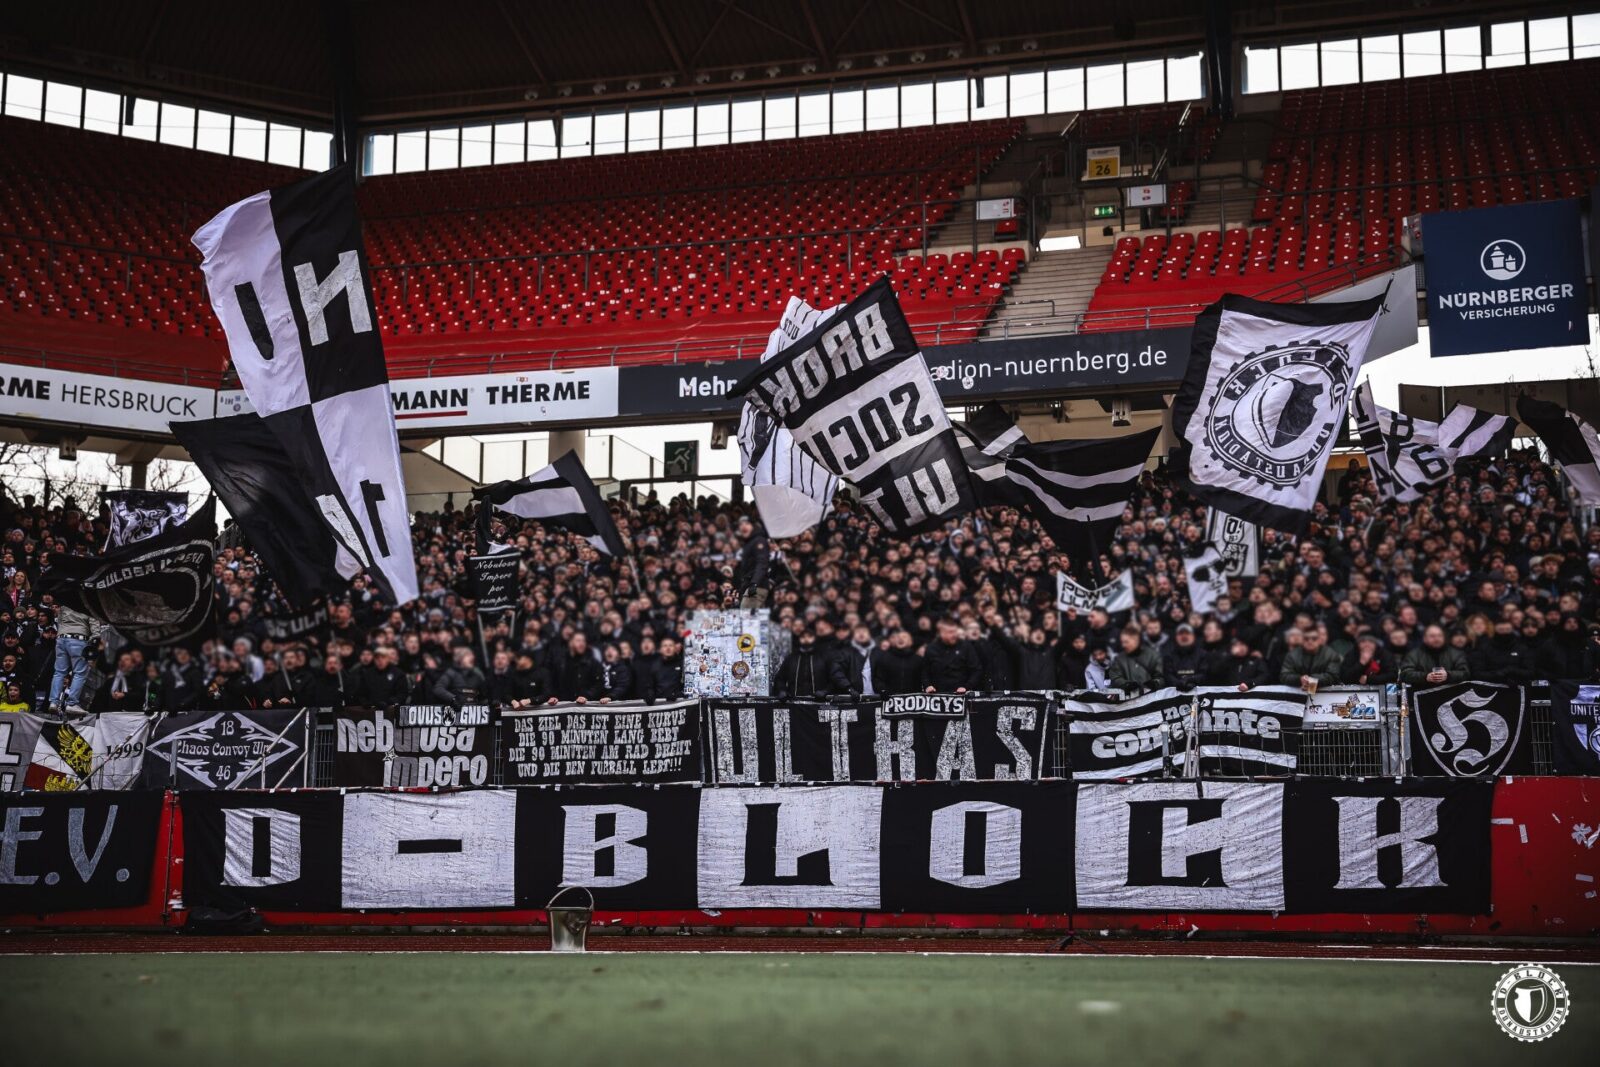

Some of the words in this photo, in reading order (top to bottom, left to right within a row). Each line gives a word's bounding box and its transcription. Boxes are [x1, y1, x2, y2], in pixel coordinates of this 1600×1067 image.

[1095, 164, 1111, 176] 26
[1438, 283, 1574, 309] NÜRNBERGER
[1460, 303, 1556, 321] VERSICHERUNG
[61, 383, 197, 417] HERSBRUCK
[486, 380, 590, 405] THERME
[884, 696, 964, 714] PRODIGYS
[221, 720, 234, 736] 18
[514, 717, 533, 733] DAS
[538, 715, 561, 731] ZIEL
[567, 714, 586, 730] DAS
[591, 714, 609, 730] IST
[614, 714, 642, 730] EINE
[647, 709, 687, 729] KURVE
[337, 710, 475, 752] nebulosa
[518, 732, 536, 747] DIE
[542, 731, 555, 746] 90
[561, 730, 609, 745] MINUTEN
[614, 729, 644, 744] LANG
[106, 742, 143, 760] 1999
[212, 742, 250, 758] Convoy
[713, 705, 1037, 782] ULTRAS
[508, 747, 525, 762] DIE
[531, 747, 546, 762] 90
[551, 745, 596, 761] MINUTEN
[601, 744, 619, 760] AM
[625, 744, 649, 760] RAD
[216, 765, 231, 780] 46
[382, 754, 488, 787] impero
[517, 763, 538, 778] UND
[543, 762, 560, 777] DIE
[565, 761, 586, 776] DEN
[0, 804, 130, 885] E.V.
[220, 797, 1448, 889] D-BLOCK
